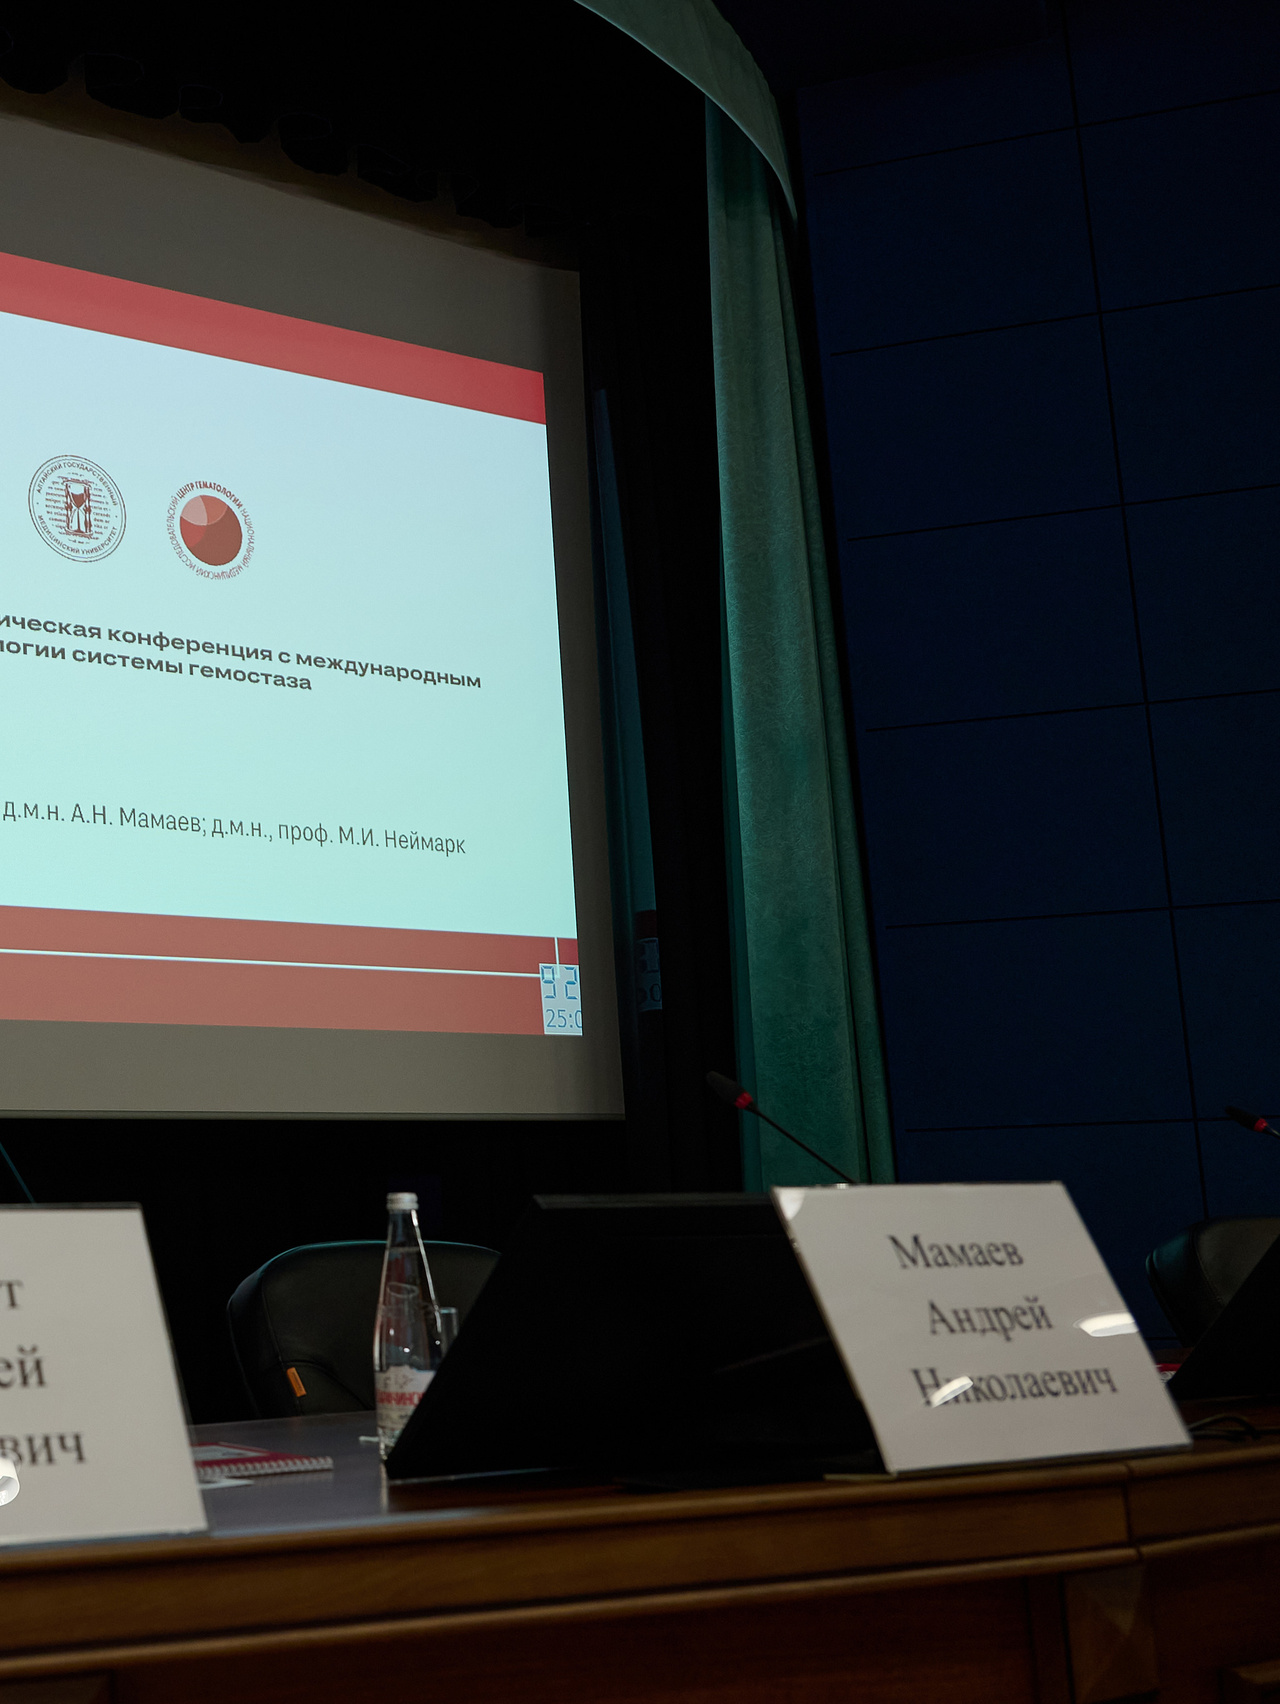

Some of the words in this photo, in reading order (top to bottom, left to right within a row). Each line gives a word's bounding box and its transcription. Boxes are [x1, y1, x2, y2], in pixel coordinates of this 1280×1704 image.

[176, 482, 195, 500] ЦЕНТР
[195, 480, 244, 509] ГЕМАТОЛОГИИ
[72, 649, 182, 674] системы
[189, 664, 312, 690] гемостаза
[108, 629, 272, 661] конференция
[278, 652, 291, 663] с
[296, 654, 481, 688] международным
[3, 801, 64, 822] д.м.н.
[71, 803, 112, 825] А.Н.
[120, 807, 206, 836] Мамаев;
[212, 819, 273, 841] д.м.н.,
[279, 823, 334, 847] проф.
[339, 826, 381, 847] М.И.
[385, 831, 466, 858] Неймарк
[887, 1233, 1025, 1271] Мамаев
[927, 1295, 1054, 1342] Андрей
